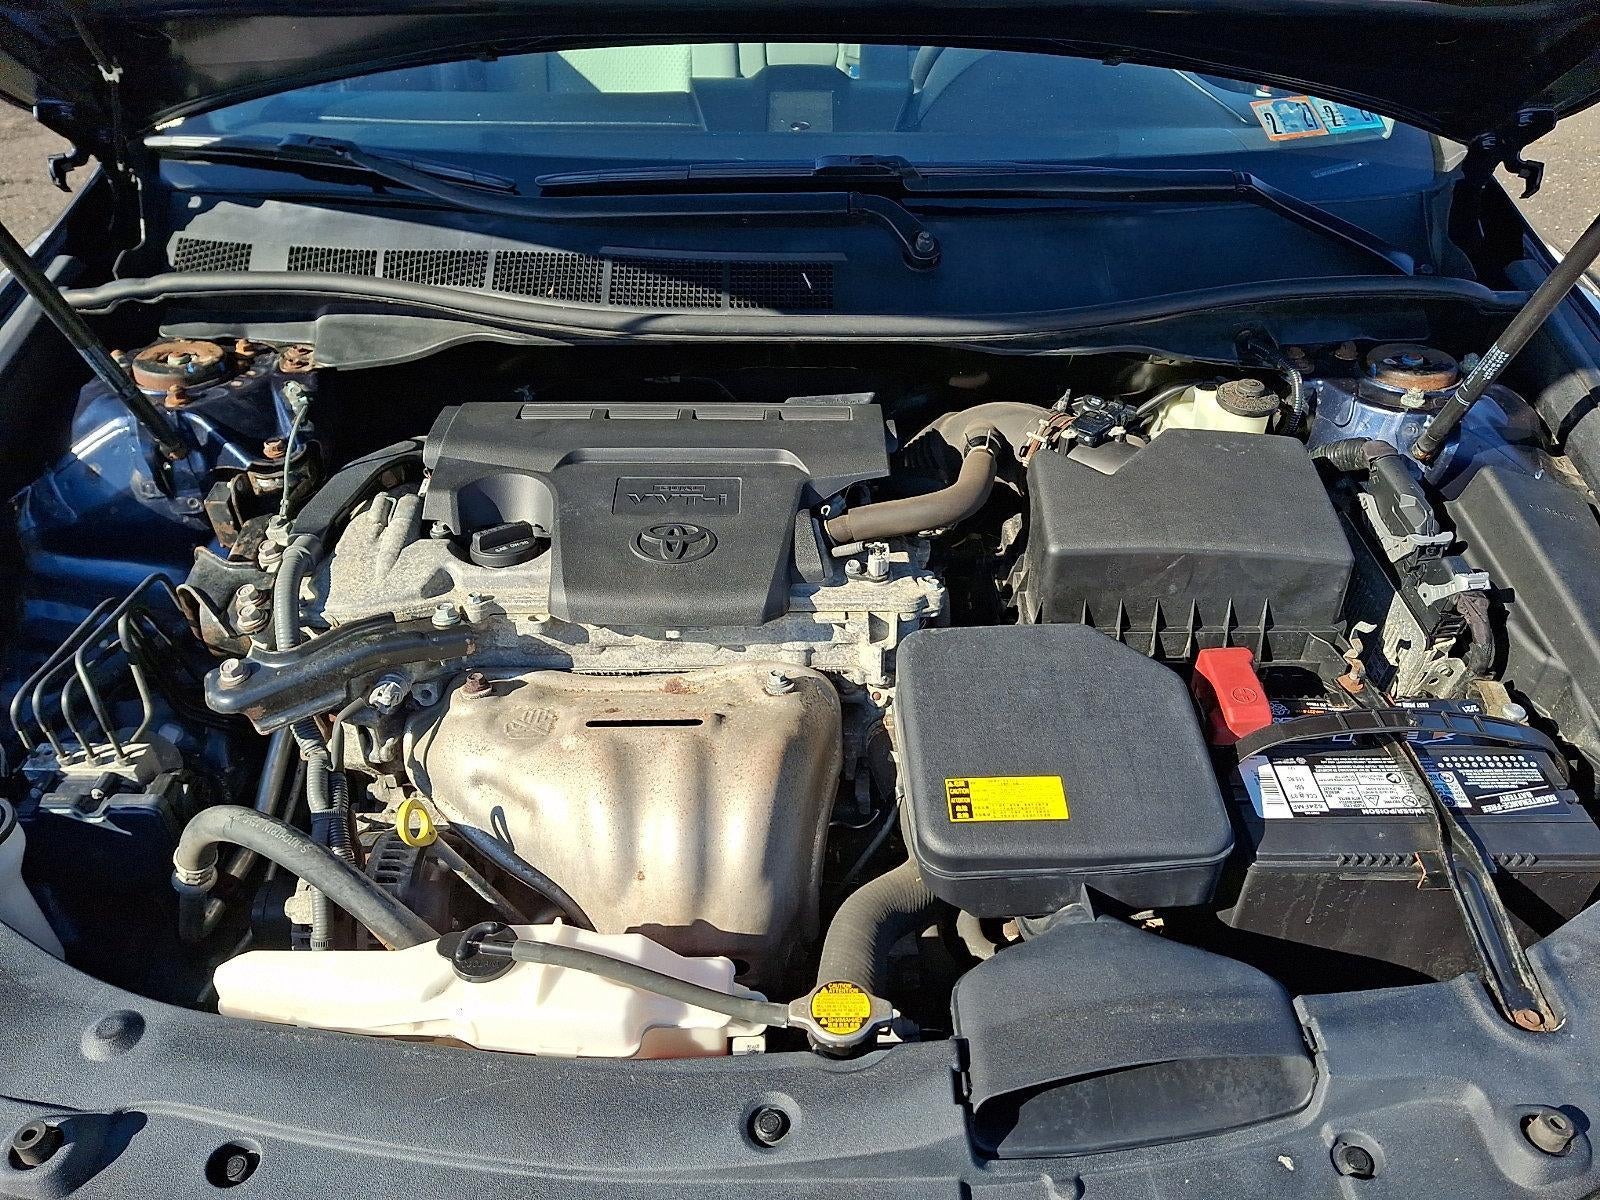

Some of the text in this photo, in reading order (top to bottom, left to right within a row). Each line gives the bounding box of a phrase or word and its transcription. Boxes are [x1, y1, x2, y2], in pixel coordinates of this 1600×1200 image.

[1264, 113, 1282, 134] 2
[1324, 105, 1341, 127] 2
[1481, 794, 1558, 814] MAINTENANCE-FREE
[1499, 791, 1533, 803] BATTERY
